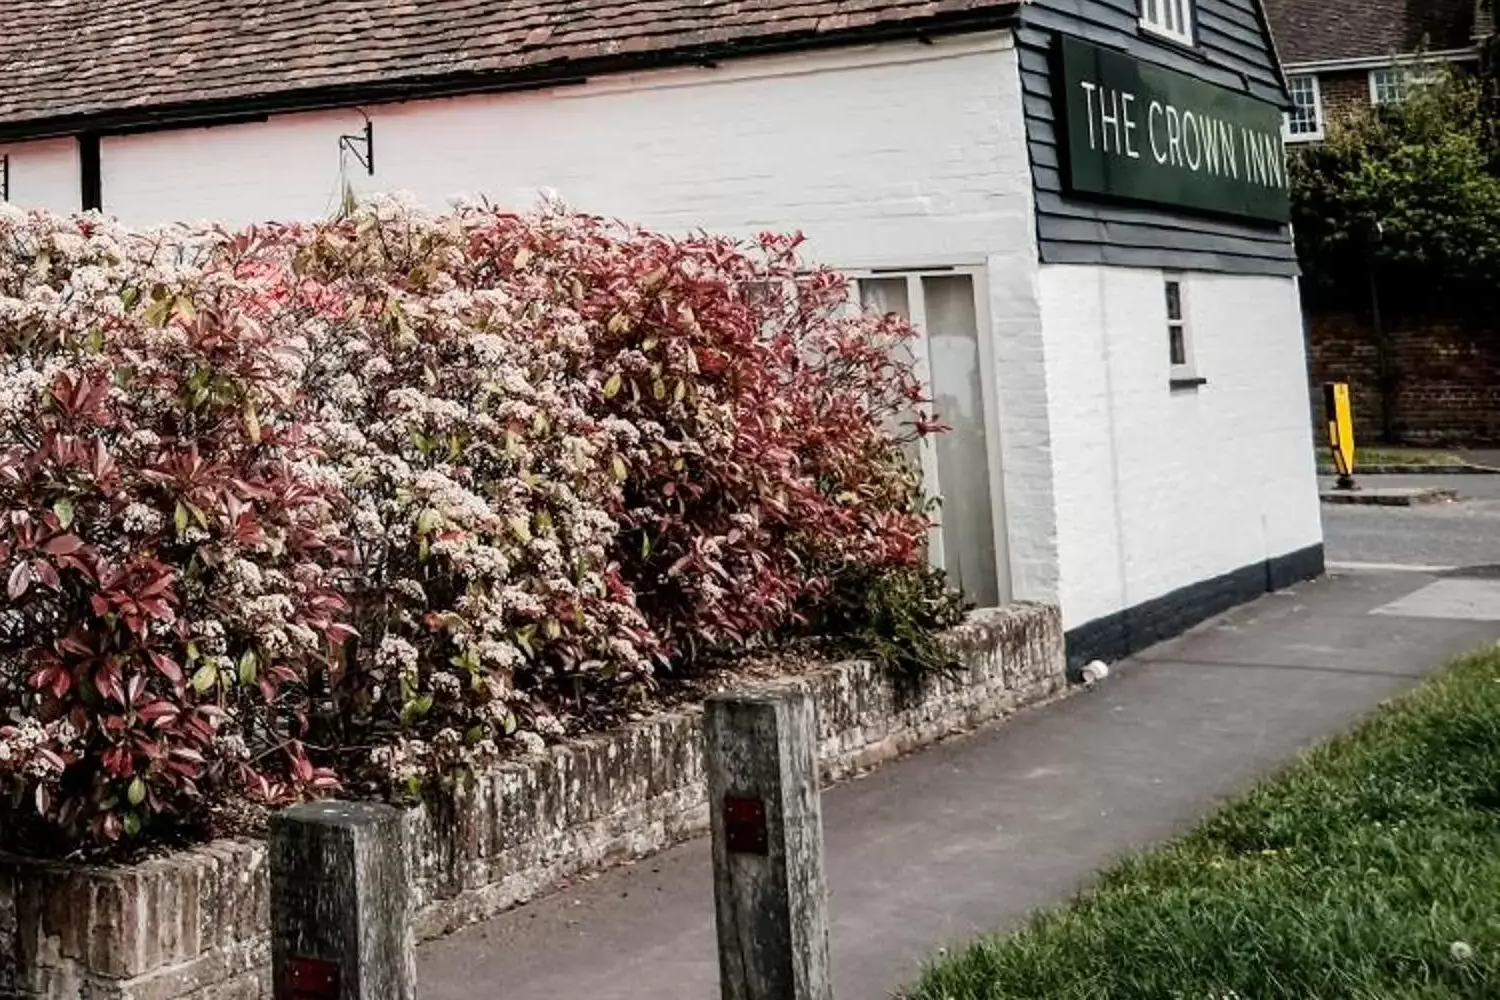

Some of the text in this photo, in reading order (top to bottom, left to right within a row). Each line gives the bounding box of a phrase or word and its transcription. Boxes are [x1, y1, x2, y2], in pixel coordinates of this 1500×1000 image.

[1081, 81, 1282, 188] THE CROWN INN
